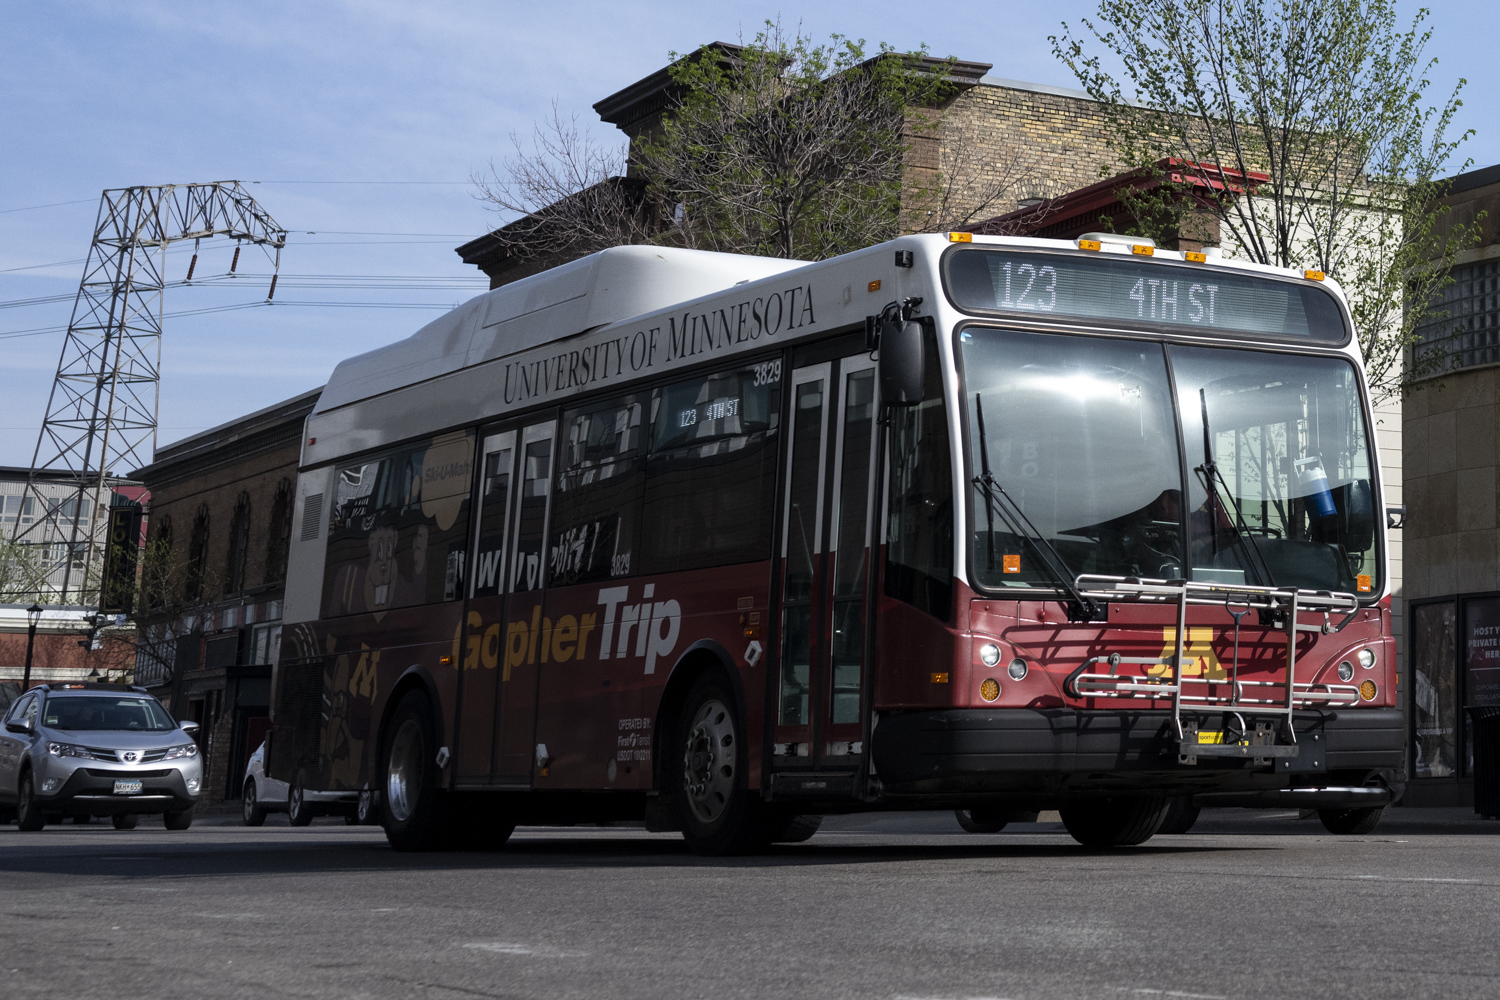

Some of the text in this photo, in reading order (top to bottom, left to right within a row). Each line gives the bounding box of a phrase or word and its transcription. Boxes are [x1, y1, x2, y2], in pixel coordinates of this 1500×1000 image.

[1001, 261, 1219, 324] 123 4TH ST
[503, 283, 817, 405] UNIVERSITY OF MINNESOTA
[753, 360, 781, 387] 3829
[680, 399, 740, 428] 123 4TH ST
[611, 553, 631, 577] 3829
[1468, 638, 1498, 648] PRIVATE
[1473, 626, 1494, 636] HOST
